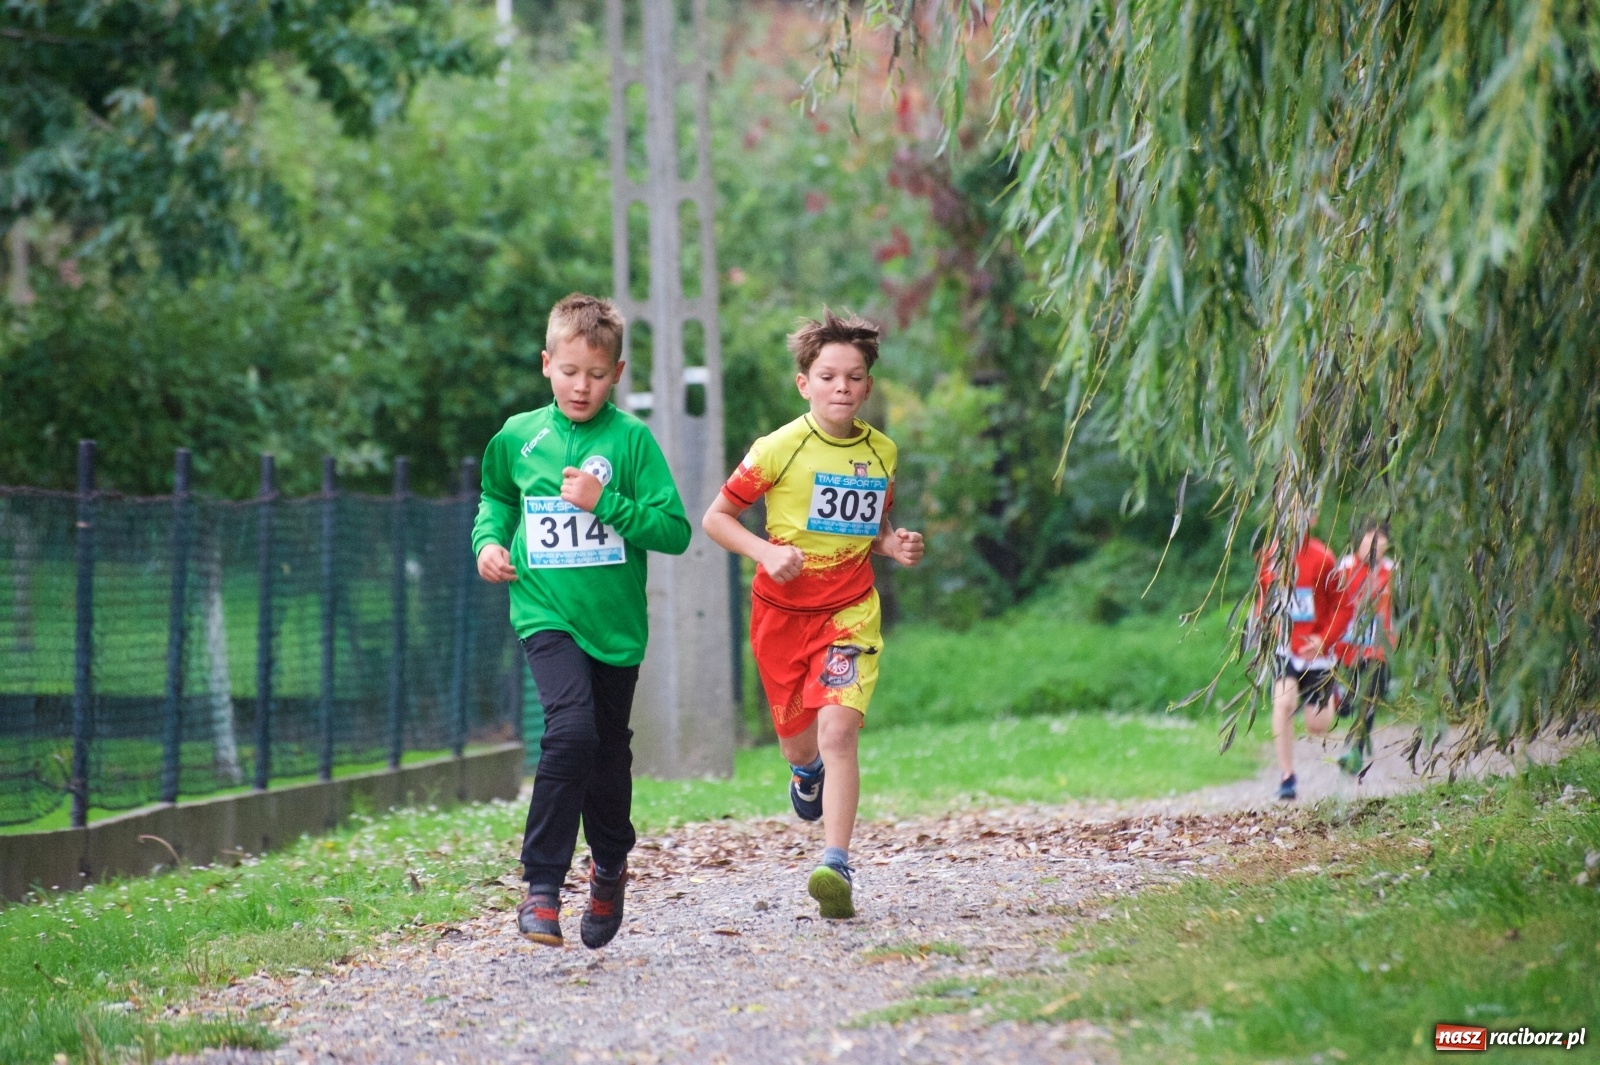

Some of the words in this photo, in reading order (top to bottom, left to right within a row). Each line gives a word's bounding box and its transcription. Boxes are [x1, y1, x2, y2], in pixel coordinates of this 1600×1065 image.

[529, 502, 582, 512] TIME-SPO
[817, 487, 878, 522] 303
[540, 516, 608, 548] 314
